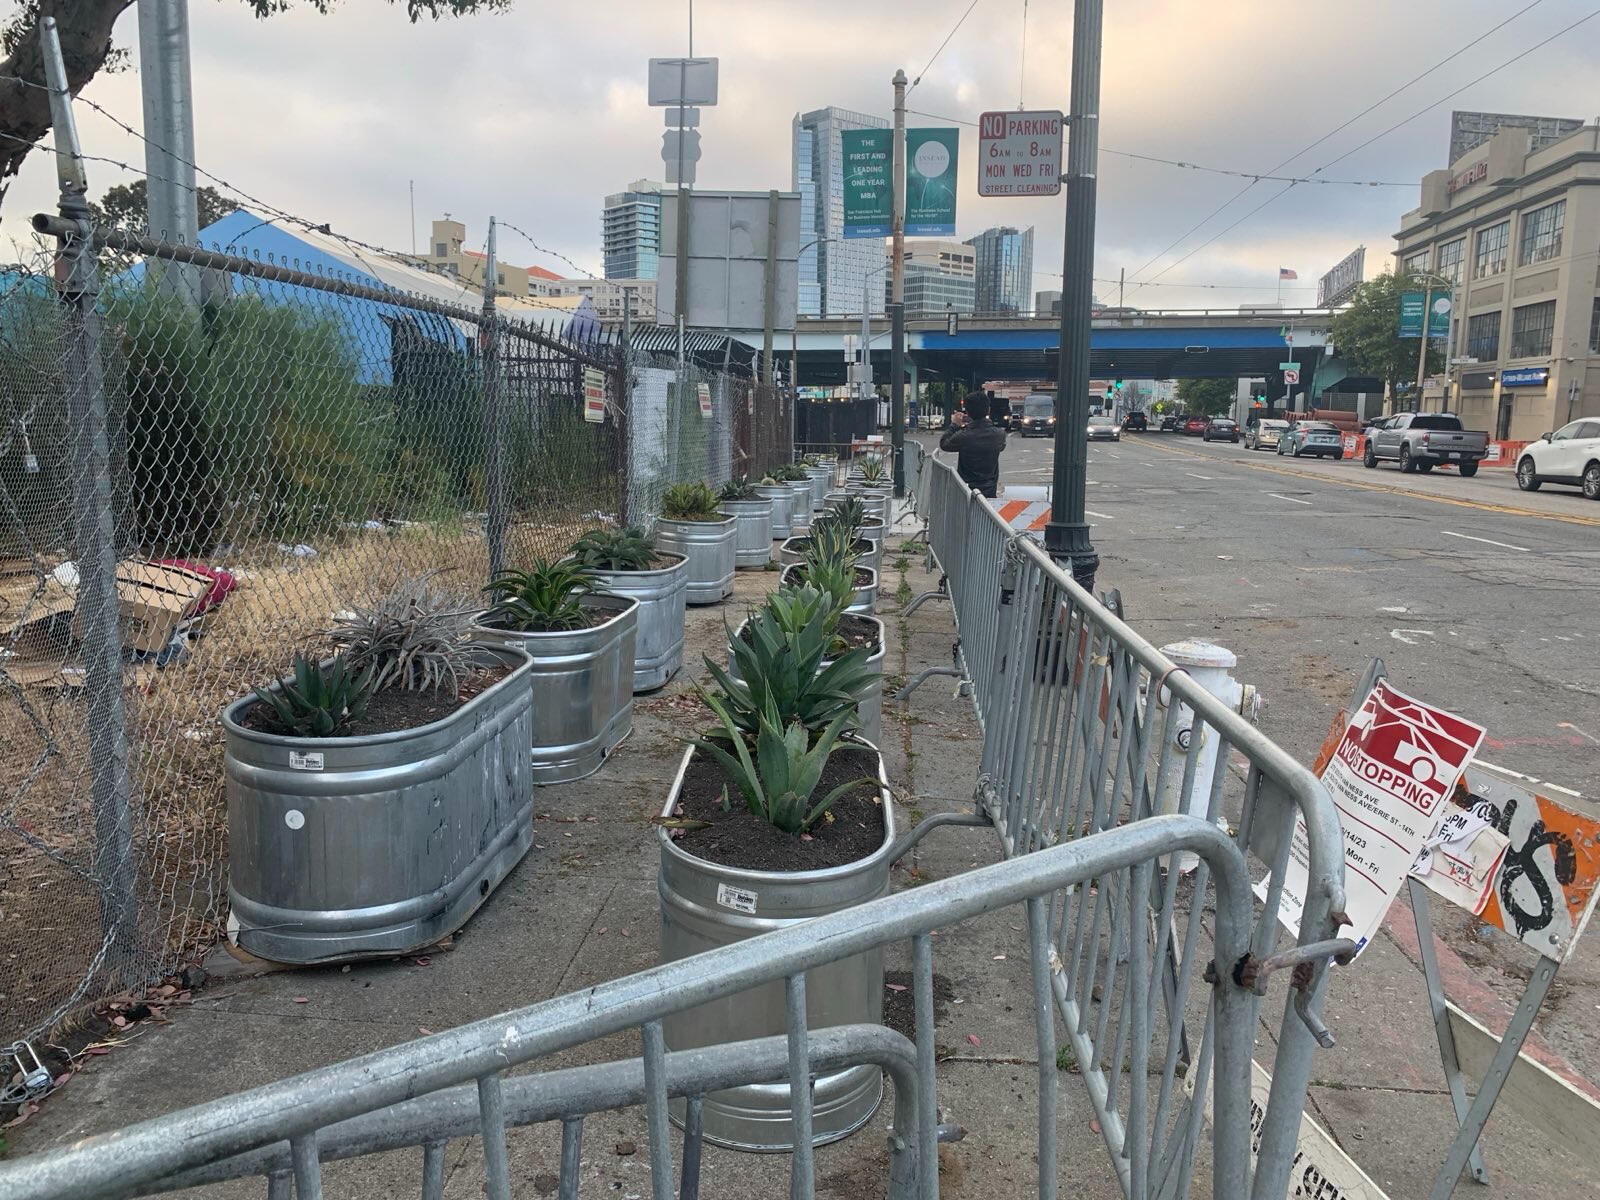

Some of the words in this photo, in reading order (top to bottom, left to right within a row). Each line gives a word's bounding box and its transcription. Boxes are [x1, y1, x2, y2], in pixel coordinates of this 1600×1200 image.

[983, 115, 1003, 136] NO
[1009, 119, 1058, 136] PARKING
[990, 142, 1011, 158] 6AM
[1030, 141, 1052, 157] 8AM
[986, 164, 1006, 178] MON
[1013, 164, 1032, 177] WED
[1039, 163, 1054, 177] FRI
[985, 184, 1013, 193] STREET
[1017, 184, 1054, 193] CLEANING
[1340, 738, 1358, 764] NO
[1352, 751, 1434, 810] STOPPING
[1348, 783, 1364, 797] NESS
[1363, 793, 1380, 806] AVE
[1343, 789, 1358, 803] NESS
[1357, 799, 1391, 821] AVE/ERIE
[1390, 816, 1400, 827] ST
[1402, 824, 1415, 837] 14TH
[1346, 847, 1364, 864] Mon
[1369, 863, 1380, 875] Fri
